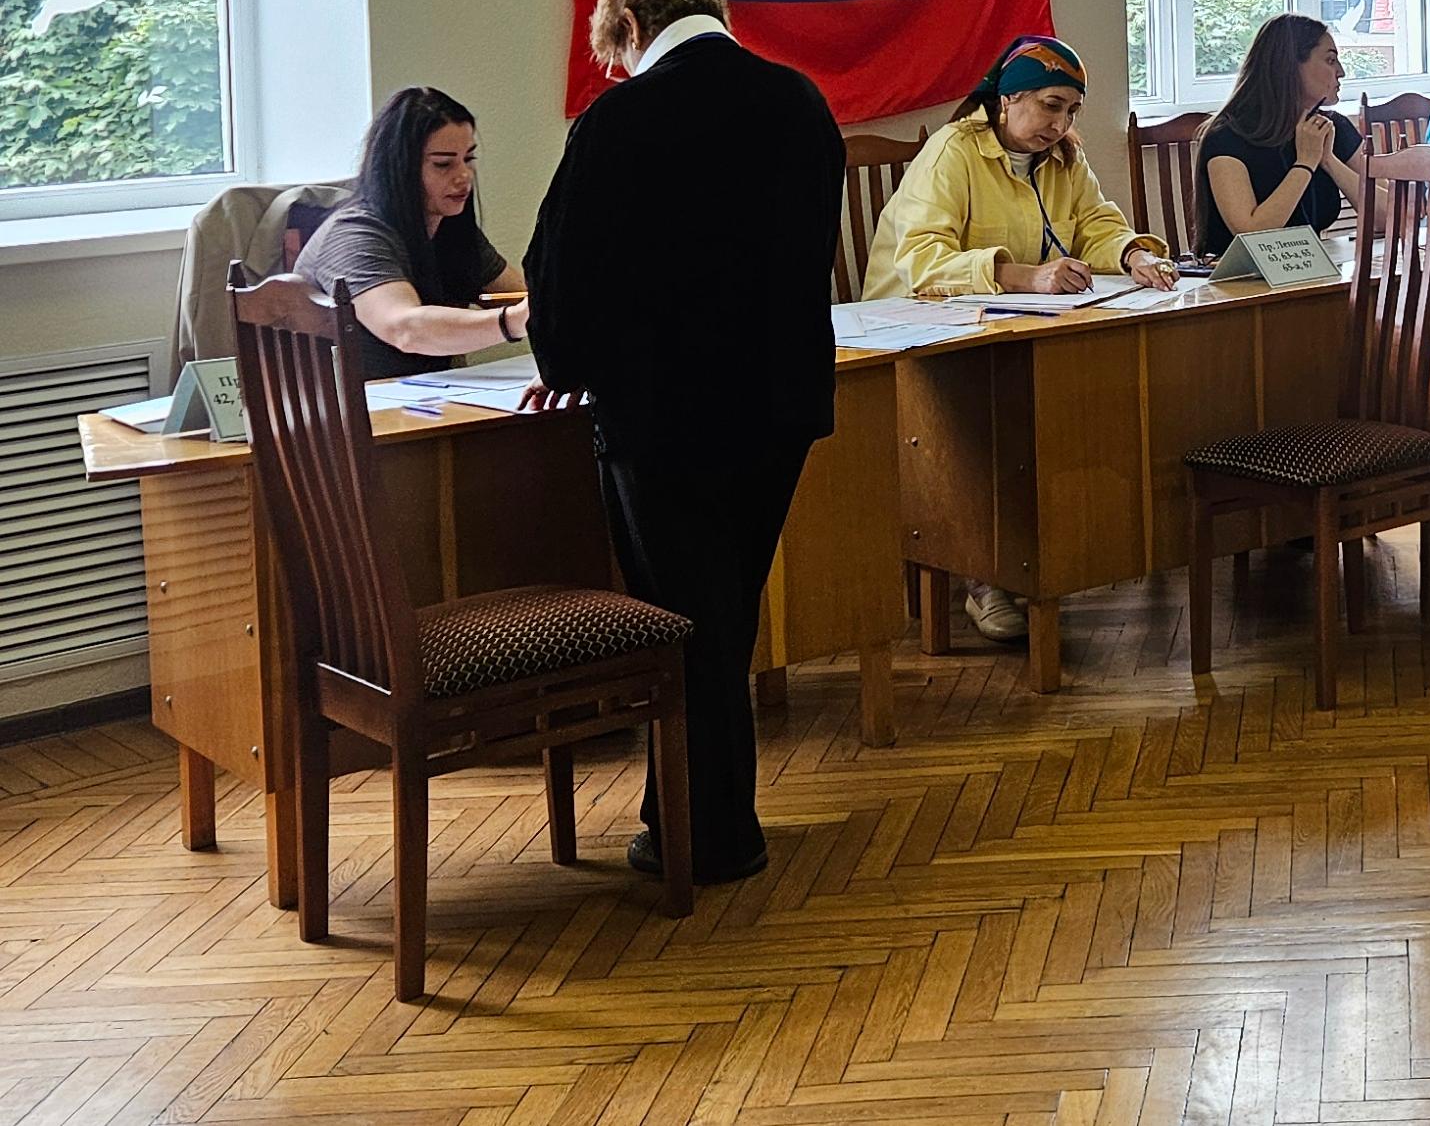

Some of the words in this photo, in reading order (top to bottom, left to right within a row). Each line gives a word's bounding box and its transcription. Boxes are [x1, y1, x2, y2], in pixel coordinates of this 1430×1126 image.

[1258, 243, 1276, 253] Пр.
[1275, 239, 1310, 249] Ленина
[214, 393, 235, 405] 42,
